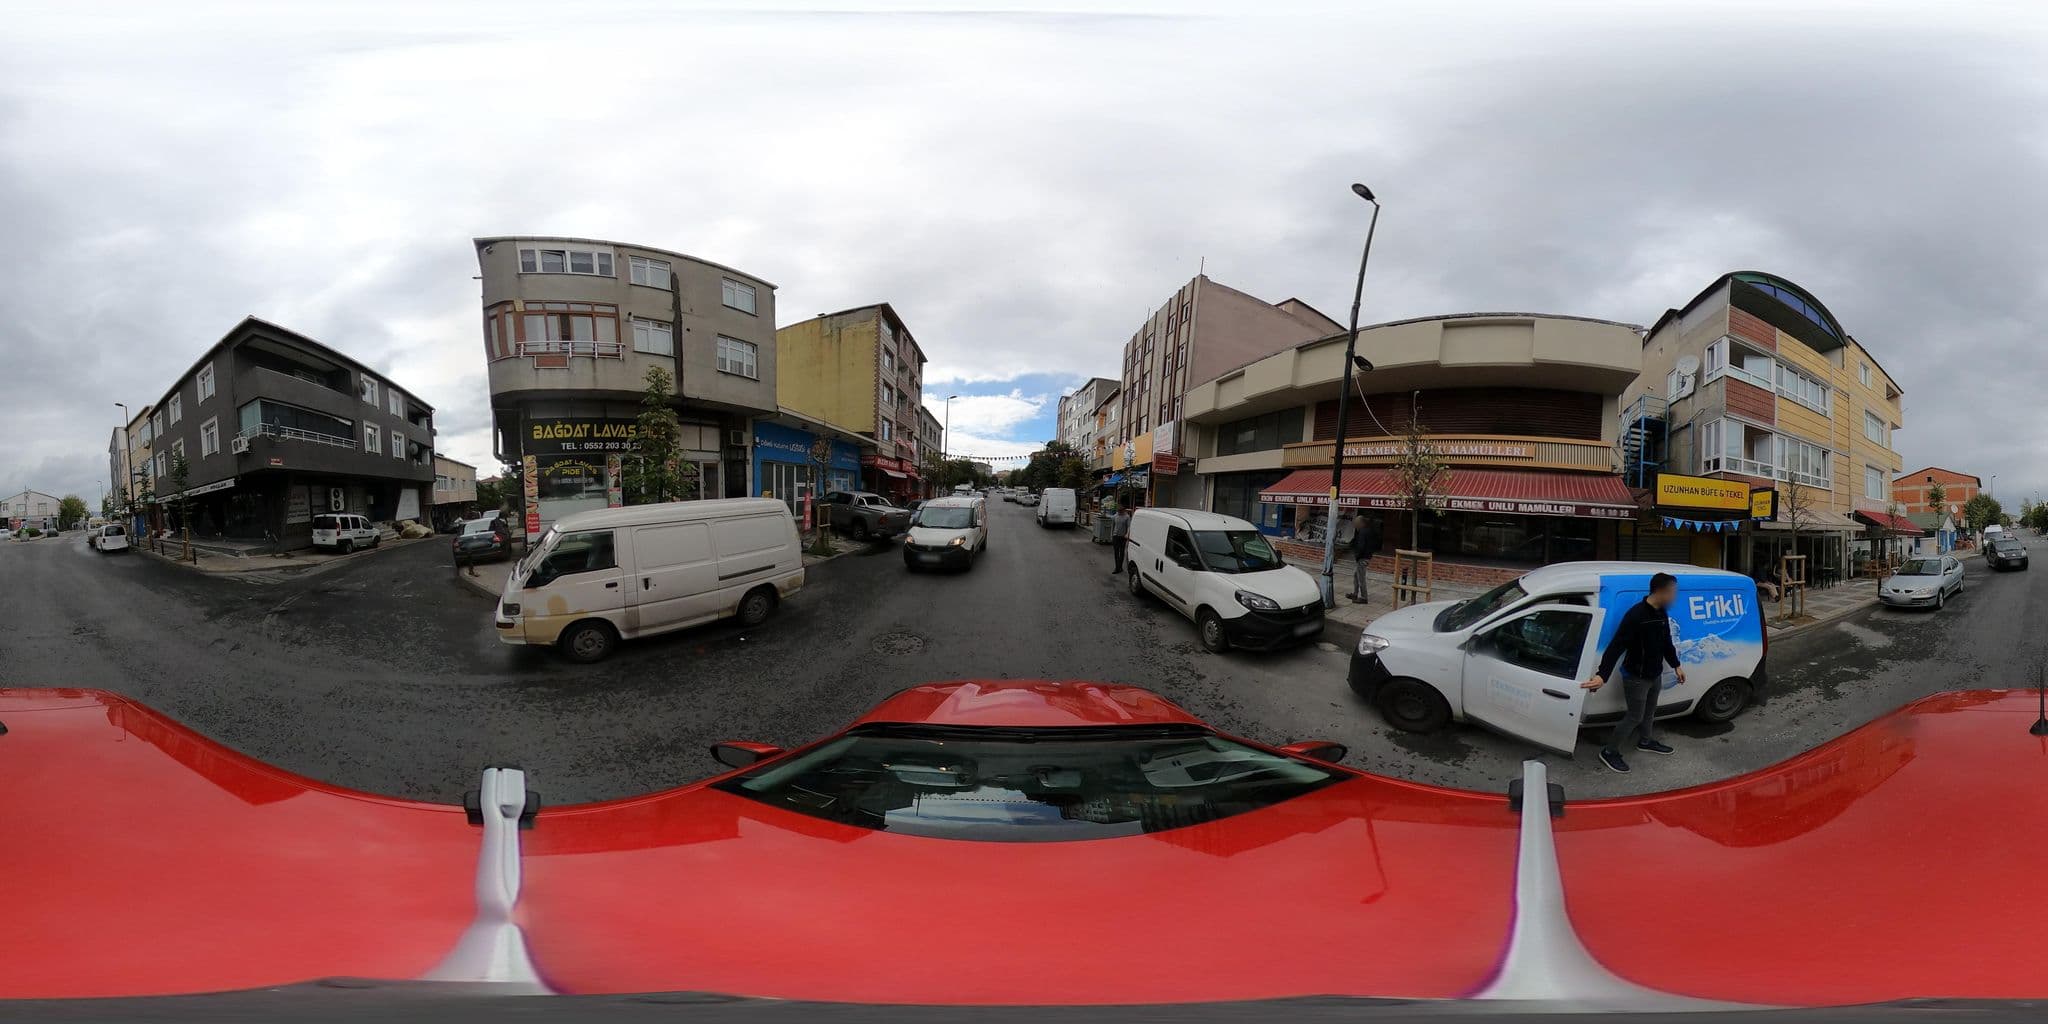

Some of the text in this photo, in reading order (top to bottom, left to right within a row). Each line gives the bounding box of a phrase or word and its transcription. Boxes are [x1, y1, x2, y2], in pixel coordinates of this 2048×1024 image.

[533, 421, 590, 439] BAĞDAT
[584, 442, 602, 450] 0552
[605, 442, 620, 450] 203
[1342, 447, 1358, 457] KIN
[1361, 446, 1398, 456] EKMEK
[1663, 484, 1700, 495] UZUNHAN
[1700, 487, 1718, 497] BÜFE
[1726, 490, 1745, 499] TEKEL
[1317, 496, 1360, 506] MALLERİ
[1451, 499, 1485, 510] EKMEK
[1488, 501, 1515, 511] UNLU
[1689, 594, 1745, 620] Erikli
